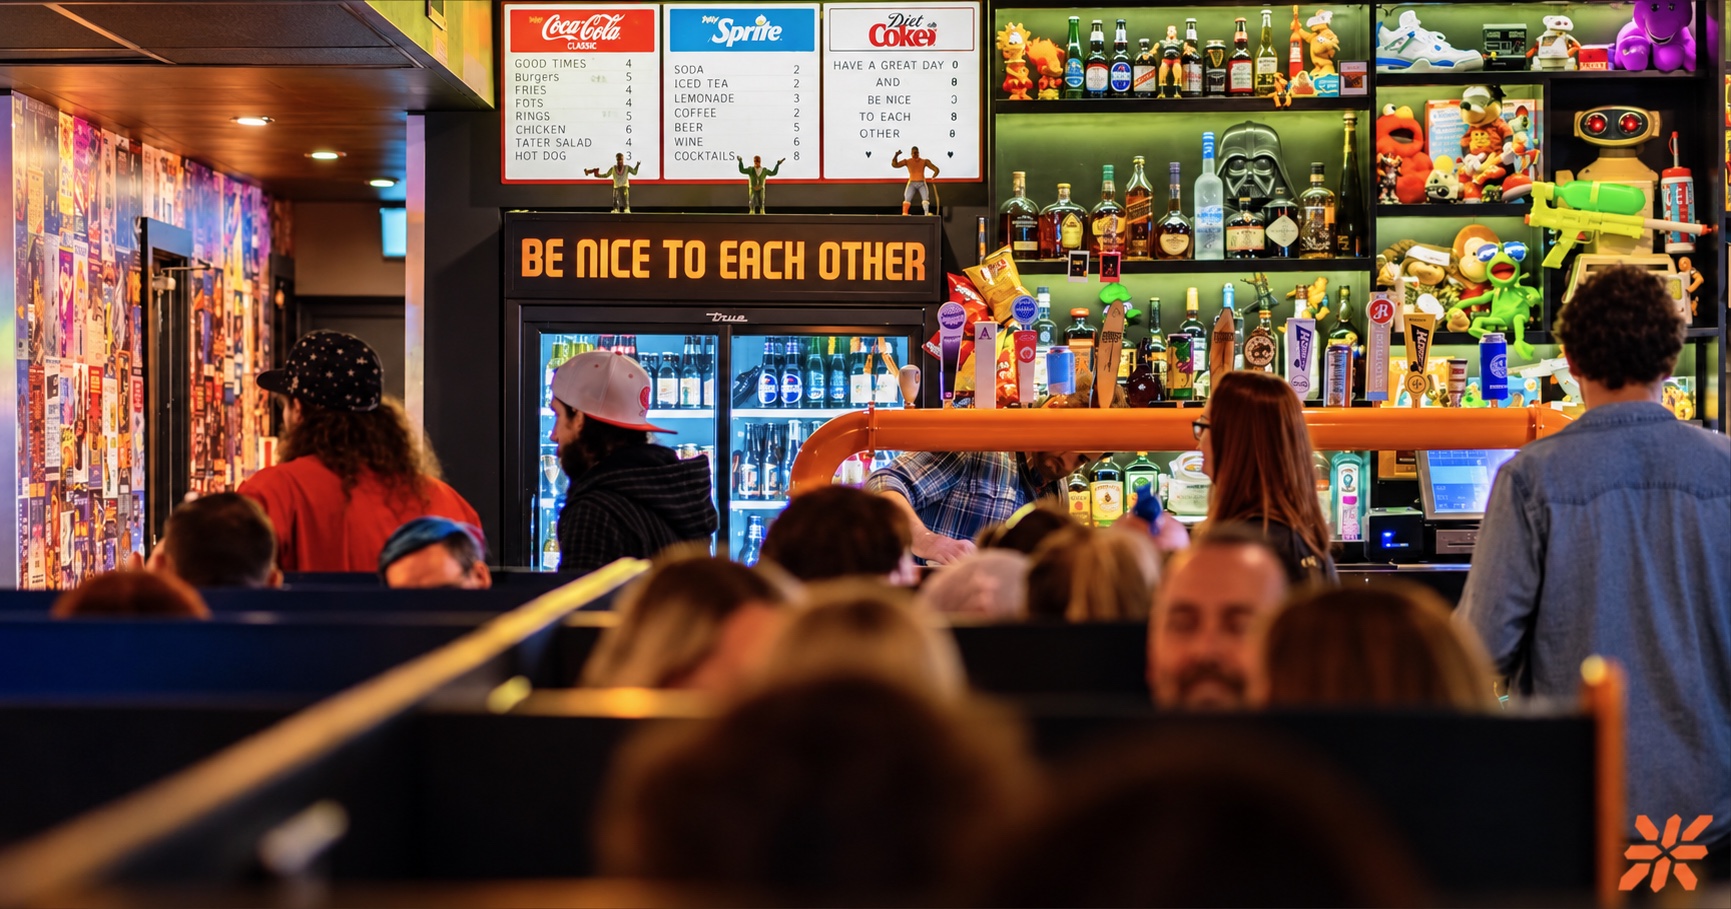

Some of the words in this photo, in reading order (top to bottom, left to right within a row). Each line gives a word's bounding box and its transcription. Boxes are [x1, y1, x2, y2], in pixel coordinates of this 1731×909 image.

[887, 12, 925, 28] Diet
[541, 13, 626, 41] Coca-Cola
[711, 14, 783, 48] Sprite
[868, 23, 937, 47] Coke
[567, 41, 598, 50] CLASSIC
[514, 58, 547, 69] GOOD
[551, 58, 587, 69] TIMES
[625, 58, 632, 68] 4
[833, 60, 863, 71] HAVE
[867, 60, 876, 70] A
[880, 60, 918, 71] GREAT
[922, 60, 945, 70] DAY
[674, 64, 704, 75] SODA
[793, 64, 800, 75] 2
[514, 72, 560, 85] Burgers
[625, 71, 633, 82] 5
[674, 78, 702, 89] ICED
[706, 78, 729, 89] TEA
[793, 78, 800, 89] 2
[875, 77, 901, 87] AND
[514, 84, 547, 95] FRIES
[625, 84, 633, 95] 4
[515, 97, 544, 109] FOTS
[625, 98, 633, 108] 4
[674, 93, 735, 104] LEMONADE
[793, 92, 800, 104] 3
[867, 94, 882, 105] BE
[885, 94, 911, 105] NICE
[515, 110, 551, 122] RINGS
[625, 110, 633, 122] 5
[674, 107, 717, 119] COFFEE
[793, 107, 800, 118] 2
[858, 111, 875, 122] TO
[880, 111, 911, 122] EACH
[515, 124, 566, 135] CHICKEN
[625, 124, 633, 135] 6
[674, 122, 703, 133] BEER
[793, 122, 801, 133] 5
[859, 128, 900, 139] OTHER
[515, 137, 551, 148] TATER
[555, 137, 593, 148] SALAD
[625, 137, 632, 147] 4
[674, 136, 704, 147] WINE
[793, 136, 801, 147] 6
[515, 150, 538, 161] HOT
[542, 150, 567, 161] DOG
[626, 150, 632, 161] 3
[674, 150, 736, 162] COCKTAILS
[793, 150, 801, 161] 8
[521, 237, 564, 278] BE
[576, 238, 651, 279] NICE
[662, 239, 707, 280] TO
[719, 239, 806, 281] EACH
[818, 240, 926, 281] OTHER
